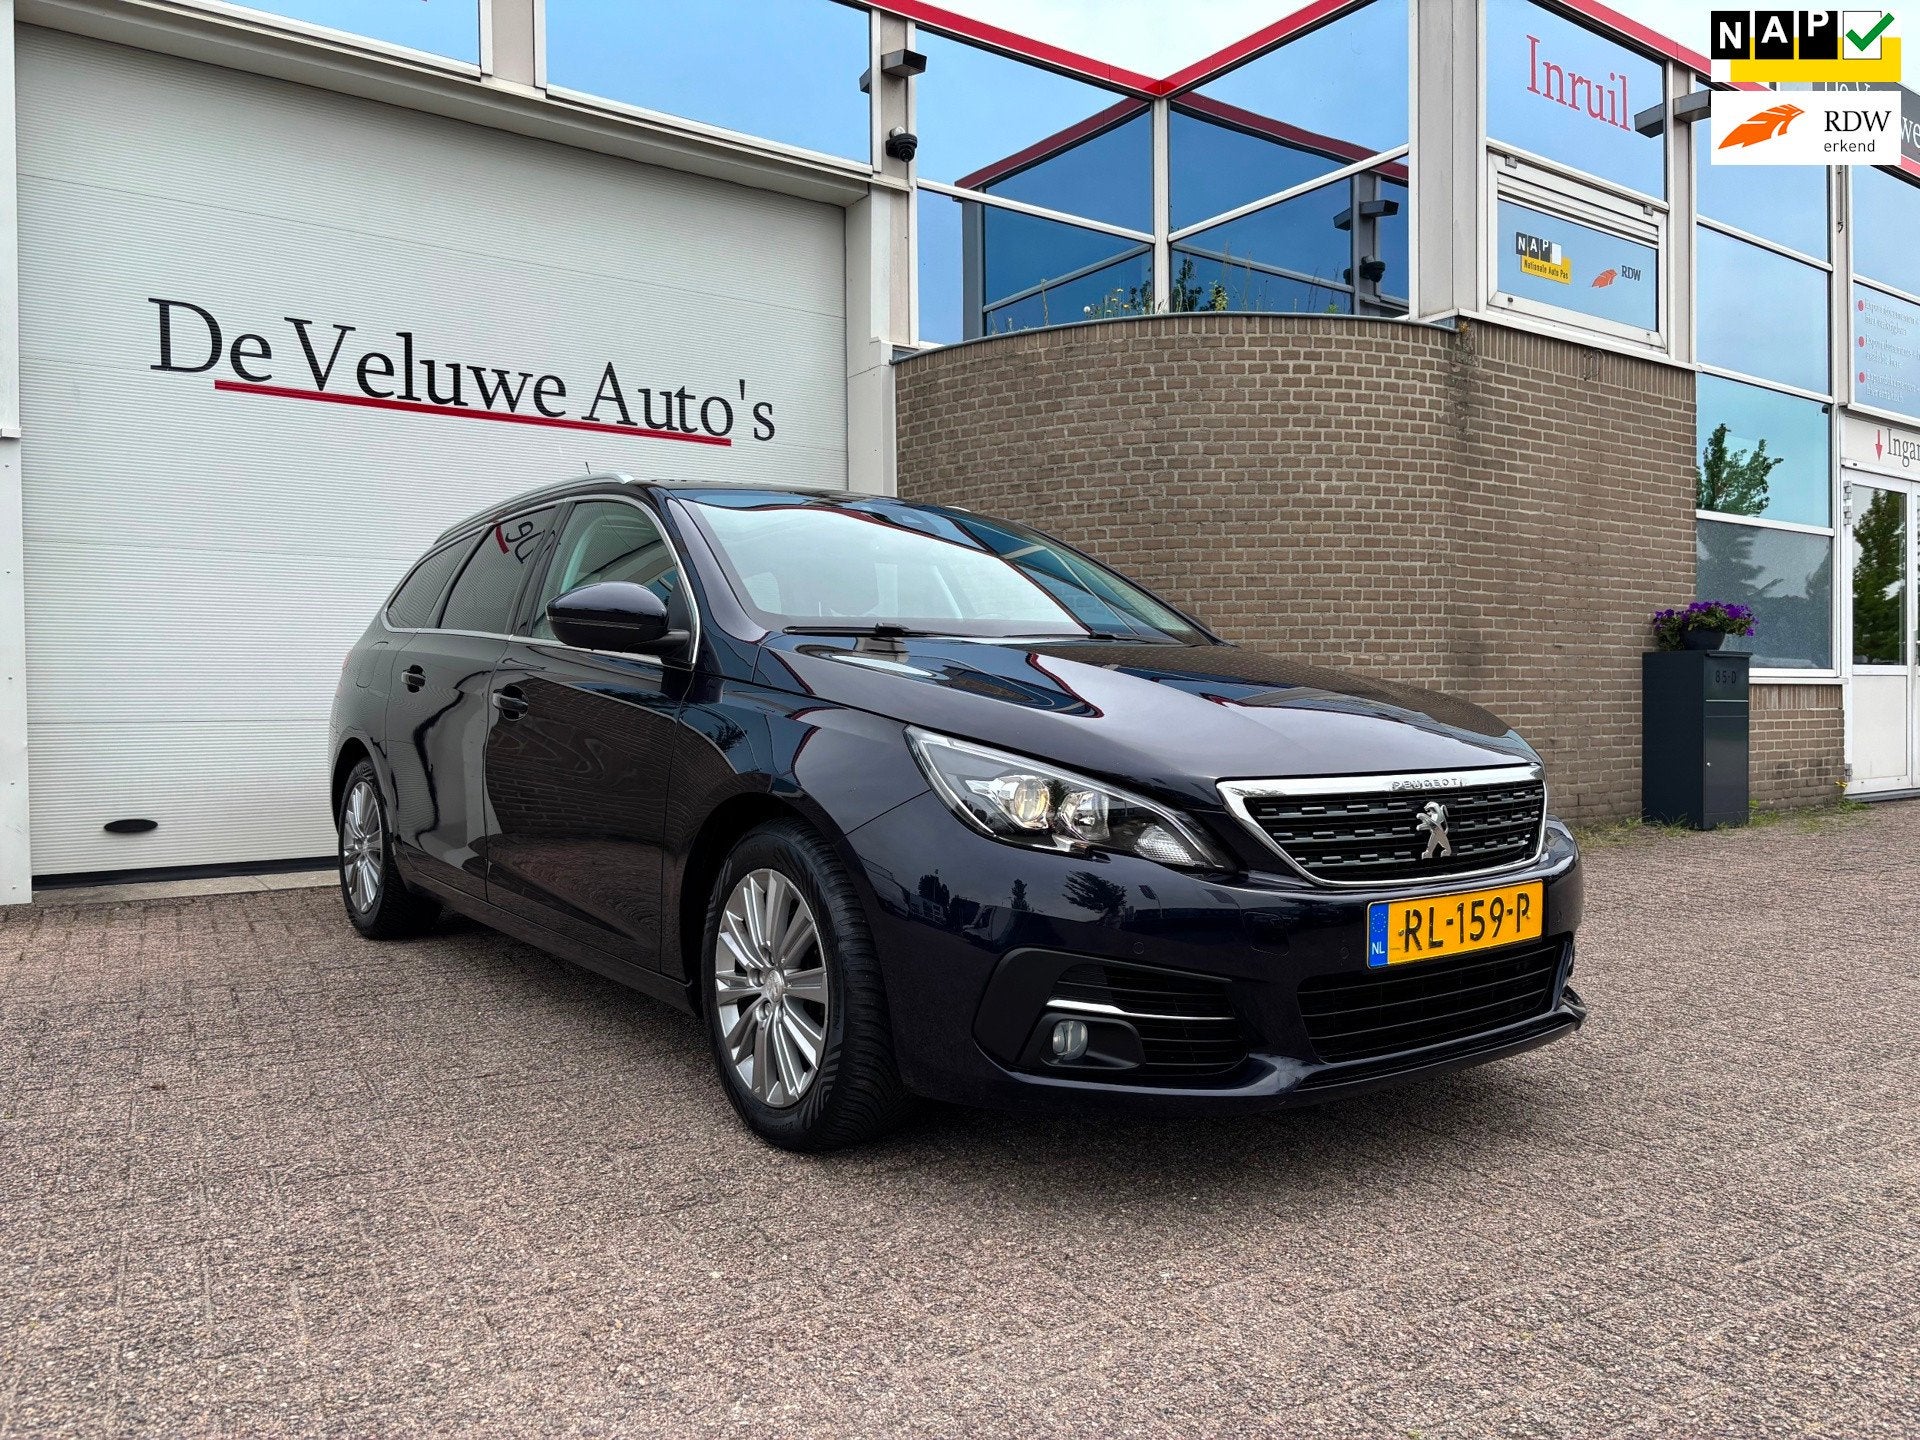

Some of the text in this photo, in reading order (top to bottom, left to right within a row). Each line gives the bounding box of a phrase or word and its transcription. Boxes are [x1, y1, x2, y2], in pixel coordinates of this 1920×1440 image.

[1526, 34, 1631, 131] Inruil
[1518, 236, 1549, 253] NAP
[1621, 265, 1641, 281] RDW
[147, 297, 776, 442] De Veluwe Auto's
[1391, 778, 1458, 791] PEUGEOT
[1404, 892, 1530, 953] RL-159-P
[1371, 941, 1385, 955] NL
